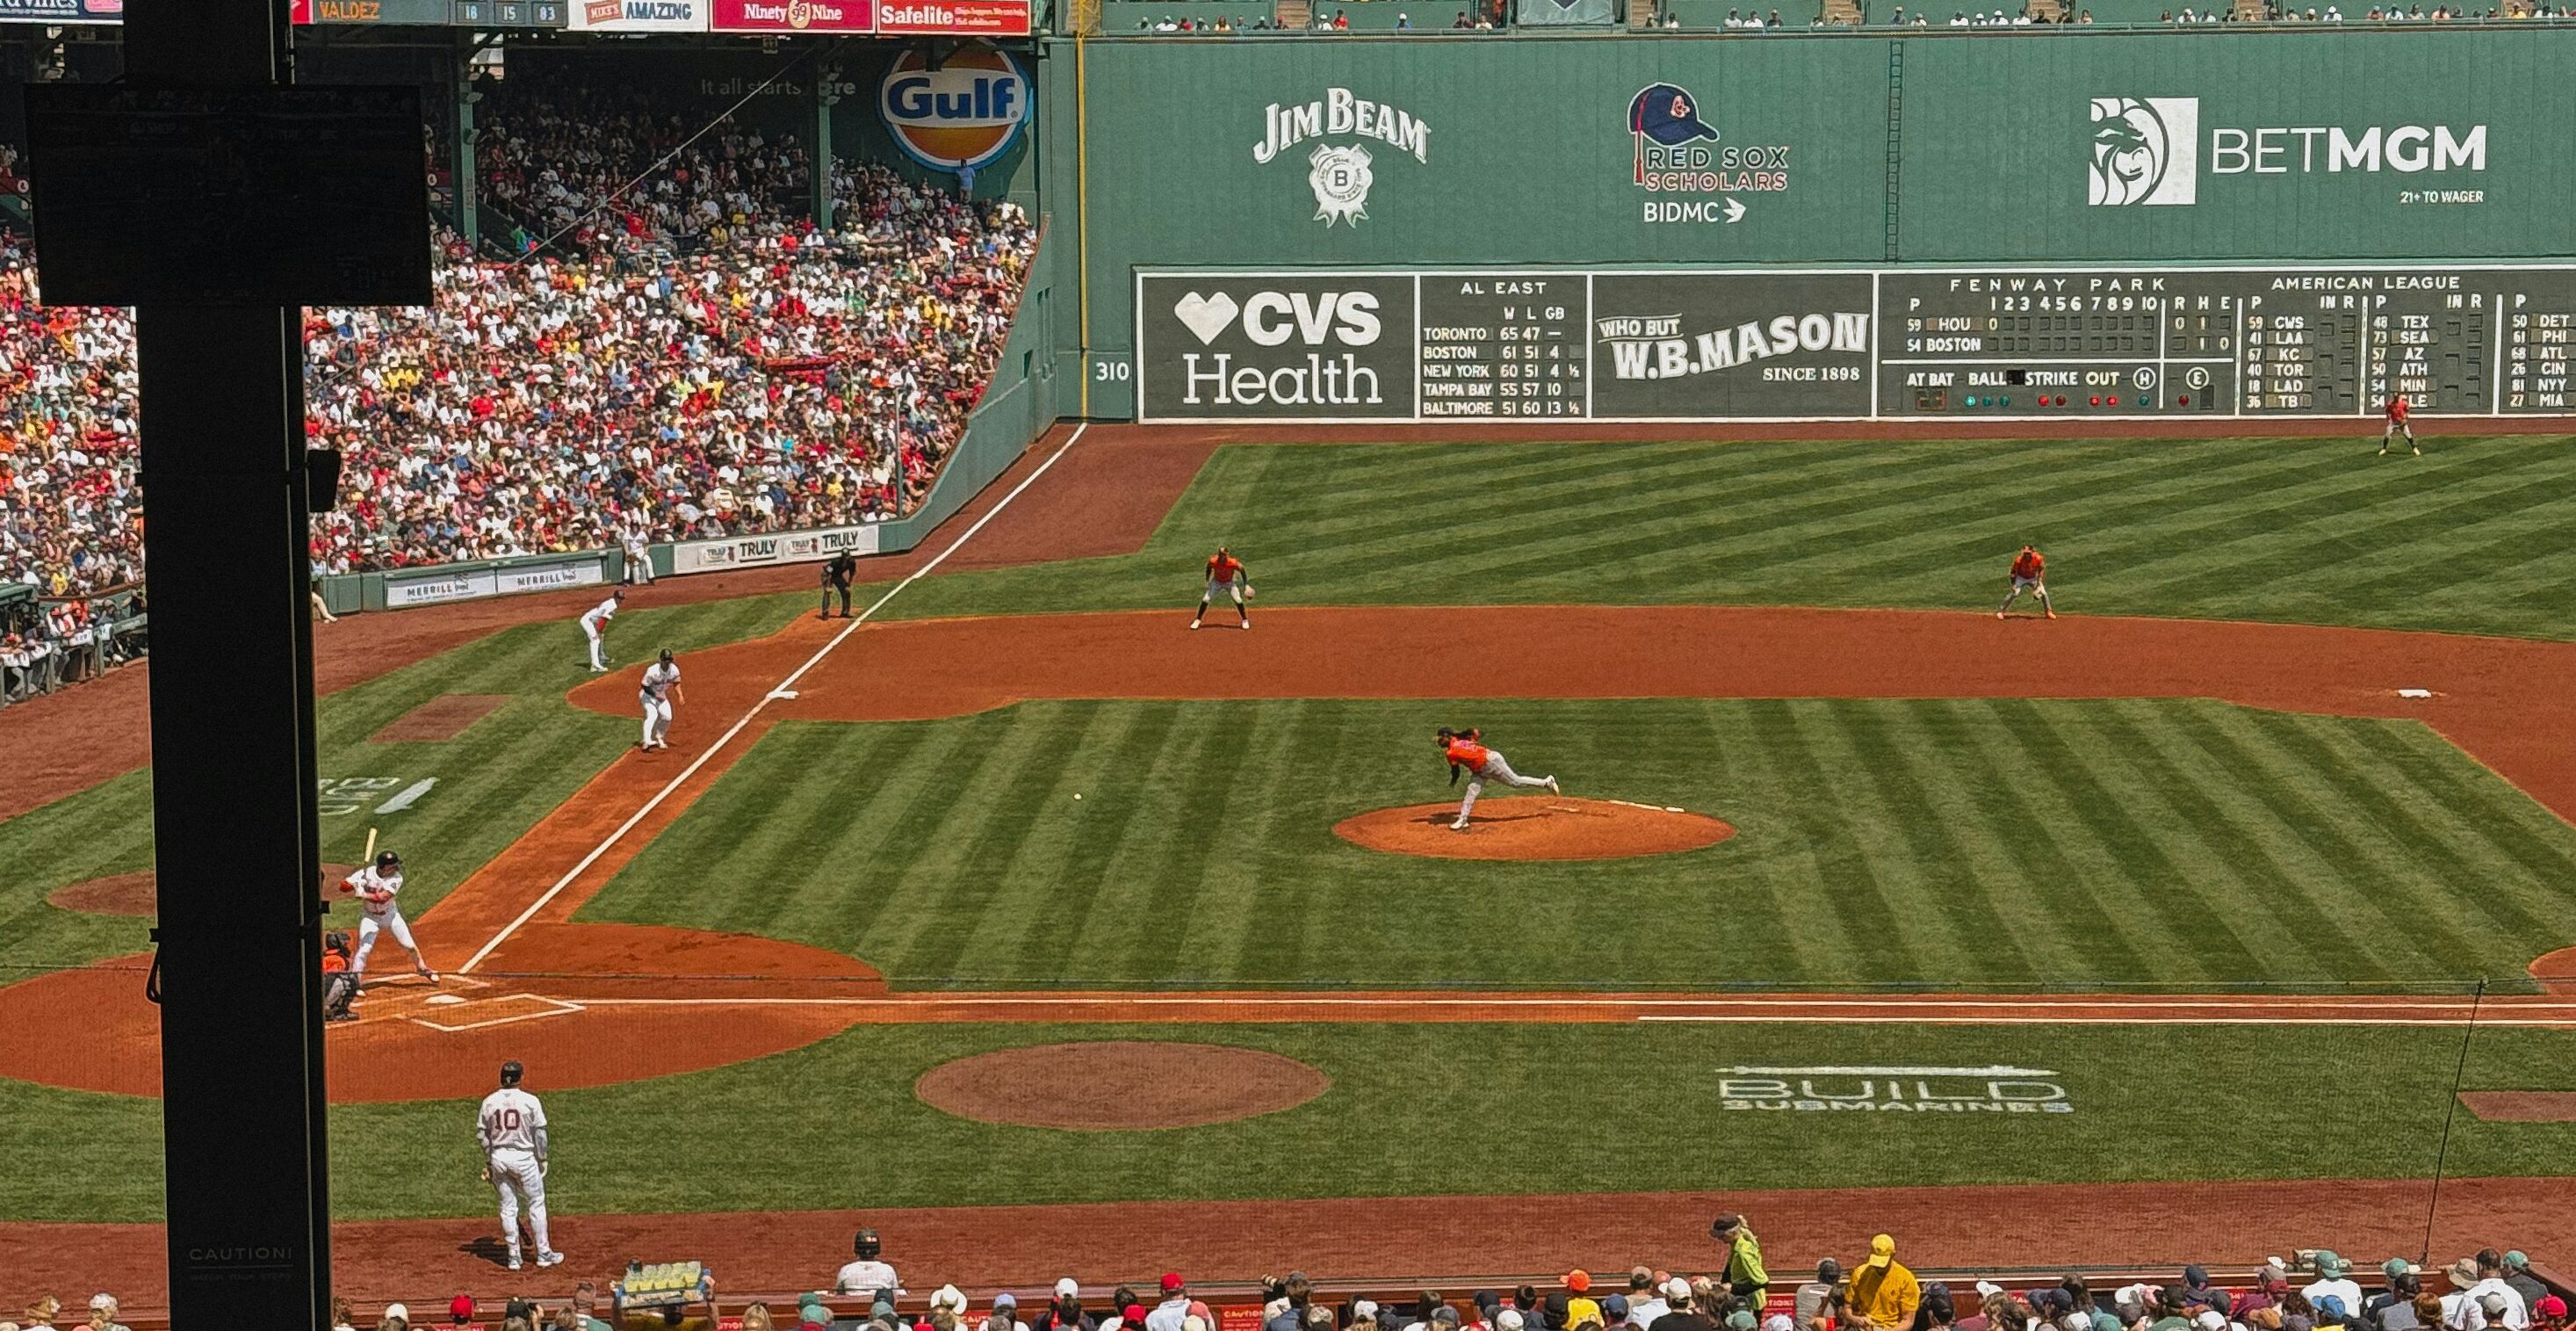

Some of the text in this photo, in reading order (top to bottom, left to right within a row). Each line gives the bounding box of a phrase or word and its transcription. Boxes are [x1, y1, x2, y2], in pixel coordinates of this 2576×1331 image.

[320, 2, 379, 19] VALDEZ
[465, 5, 477, 19] 18
[504, 5, 516, 21] 15
[626, 2, 691, 19] AMAZING
[744, 4, 787, 23] Ninety
[812, 4, 842, 21] Nine
[881, 6, 954, 25] Safelite
[719, 78, 741, 95] all
[747, 80, 802, 95] starts
[887, 77, 1015, 119] Gulf
[1253, 88, 1428, 164] JIM BEAM
[2212, 126, 2486, 173] BETMGM
[1647, 147, 1790, 170] RED SOX
[1334, 170, 1348, 187] B
[1644, 172, 1788, 192] SCHOLARS
[2400, 191, 2484, 204] 21+ TO WAGER
[1644, 202, 1718, 222] BIDMC
[1461, 282, 1547, 294] AL EAST
[1950, 278, 2164, 292] FENWAY PARK
[2271, 277, 2460, 290] AMERICAN LEAGUE
[1910, 296, 2231, 311] P 1 2 3 4 5 6 7 8 9 10 R H E
[2251, 293, 2526, 309] P IN R P IN R P
[1243, 291, 1382, 346] CVS
[1504, 307, 1565, 320] W L GB
[1598, 318, 1680, 337] WHO BUT
[1907, 316, 2205, 332] 59 HOU 0 0 1
[2248, 316, 2304, 329] 59 CWS
[2373, 315, 2429, 329] 48 TEX
[2513, 315, 2570, 329] 50 DET
[1424, 327, 1541, 340] TORONTO 65 47
[2248, 332, 2303, 344] 41 LAA
[2373, 330, 2430, 344] 73 SEA
[2513, 330, 2567, 344] 61 PHI
[1907, 336, 2229, 352] 54 BOSTON 1 0
[1424, 345, 1560, 359] BOSTON 61 51 4
[2279, 348, 2300, 361] KC
[2372, 347, 2425, 360] 57 AZ
[2540, 346, 2567, 360] ATL
[1096, 362, 1129, 381] 310
[1424, 365, 1451, 377] NEW
[1455, 365, 1490, 377] YORK
[1500, 365, 1519, 377] 60
[1525, 365, 1539, 377] 51
[1550, 365, 1560, 377] 4
[1763, 367, 1860, 381] SINCE 1898
[2247, 363, 2304, 376] 40 TOR
[2372, 362, 2428, 376] 50 ATH
[2511, 362, 2566, 376] 26 CIN
[1183, 353, 1382, 405] Health
[1907, 372, 2202, 387] AT BAT BALL STRIKE OUT H E
[2371, 378, 2427, 392] 54 MIN
[2537, 378, 2567, 392] NYY
[1424, 383, 1562, 396] TAMPA BAY 55 57 10
[2248, 380, 2303, 393] 18 LAD
[1424, 401, 1493, 415] BALTIMORE
[1502, 401, 1517, 415] 51
[1523, 401, 1541, 415] 60
[1548, 401, 1562, 415] 13
[2247, 395, 2298, 409] 36 TB
[2371, 394, 2385, 408] 54
[2539, 394, 2565, 408] MIA
[739, 539, 777, 556] TRULY
[822, 532, 859, 548] TRULY
[1719, 1079, 2066, 1101] BUILD
[1722, 1100, 2075, 1113] SUBMARINES
[494, 1109, 520, 1131] 10
